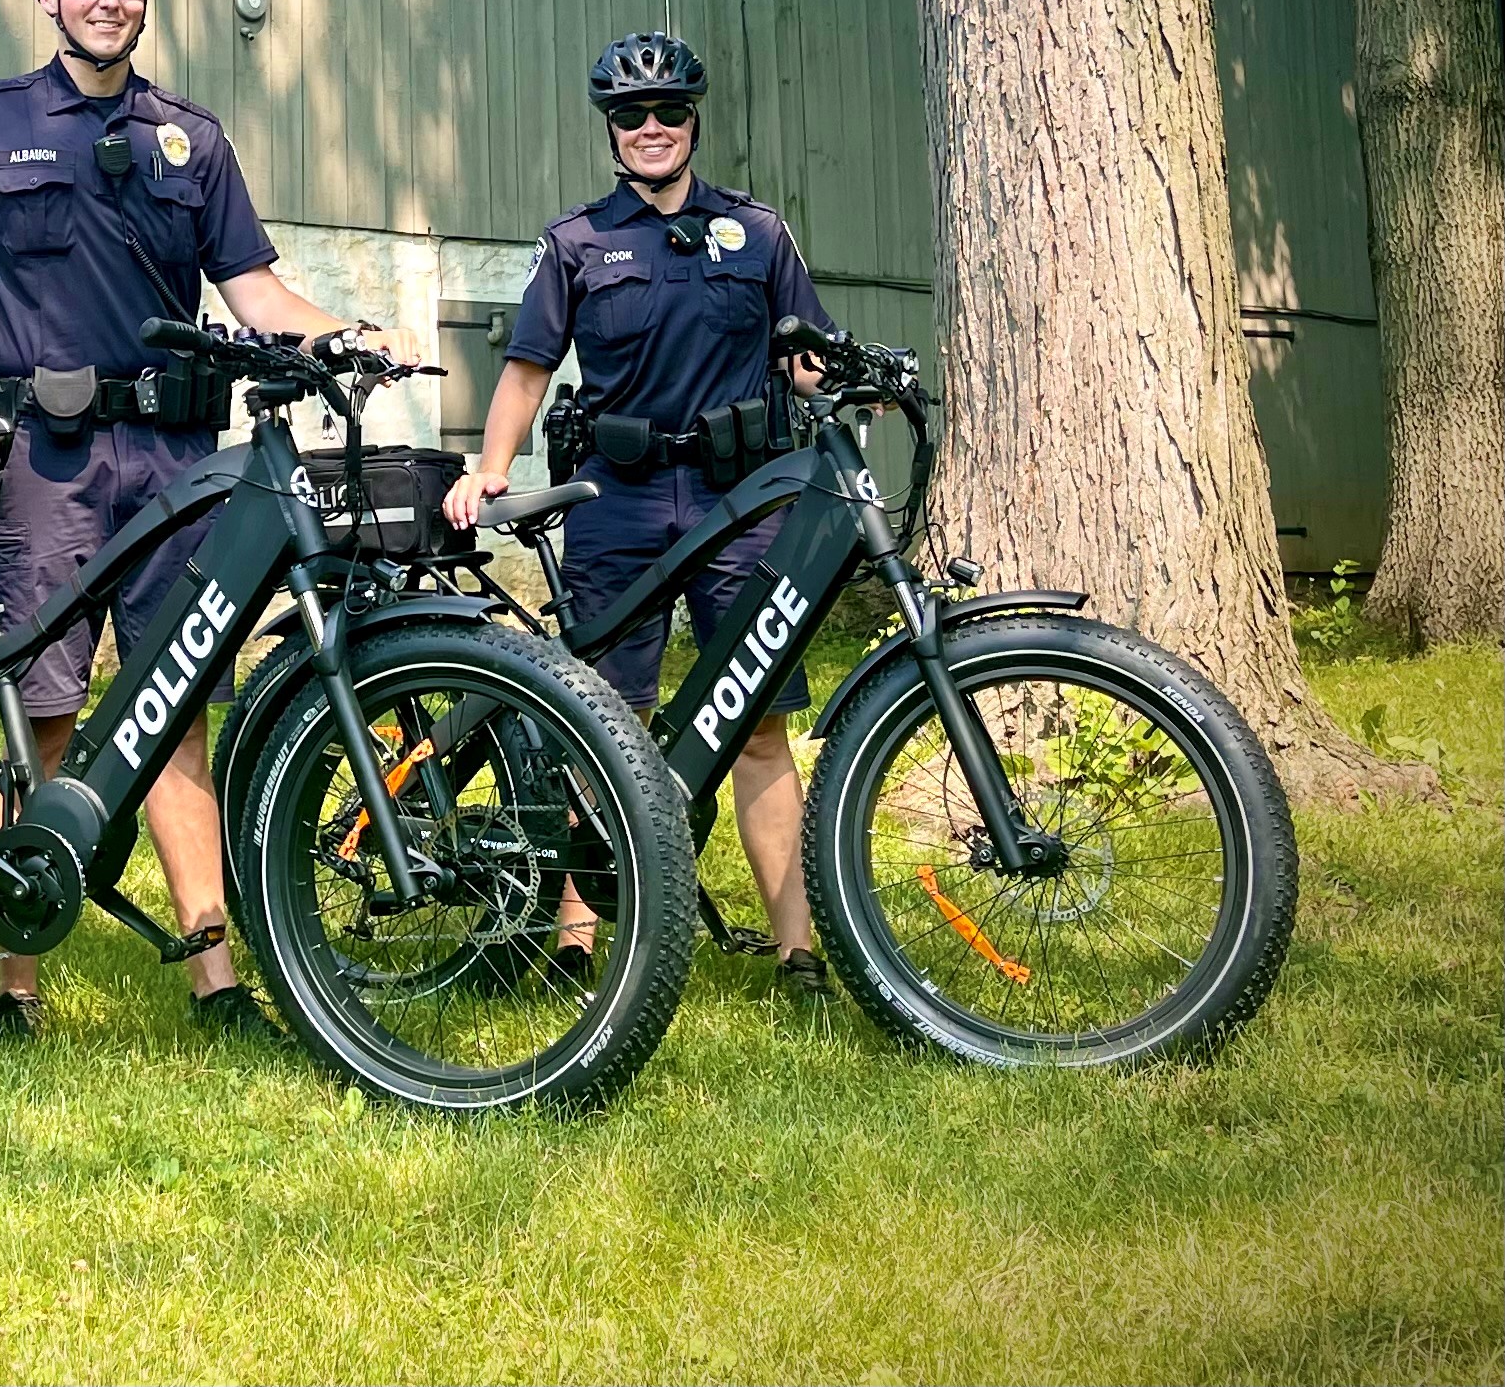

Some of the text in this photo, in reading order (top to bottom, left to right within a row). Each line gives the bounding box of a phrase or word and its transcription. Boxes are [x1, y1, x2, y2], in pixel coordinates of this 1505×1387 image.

[9, 149, 57, 163] ALBAUGH
[603, 250, 634, 264] COOK
[112, 578, 237, 771] POLICE
[692, 575, 810, 753] POLICE
[1161, 685, 1205, 723] KENDA
[255, 741, 291, 834] JUGGERNAUT
[579, 1024, 614, 1069] KENDA
